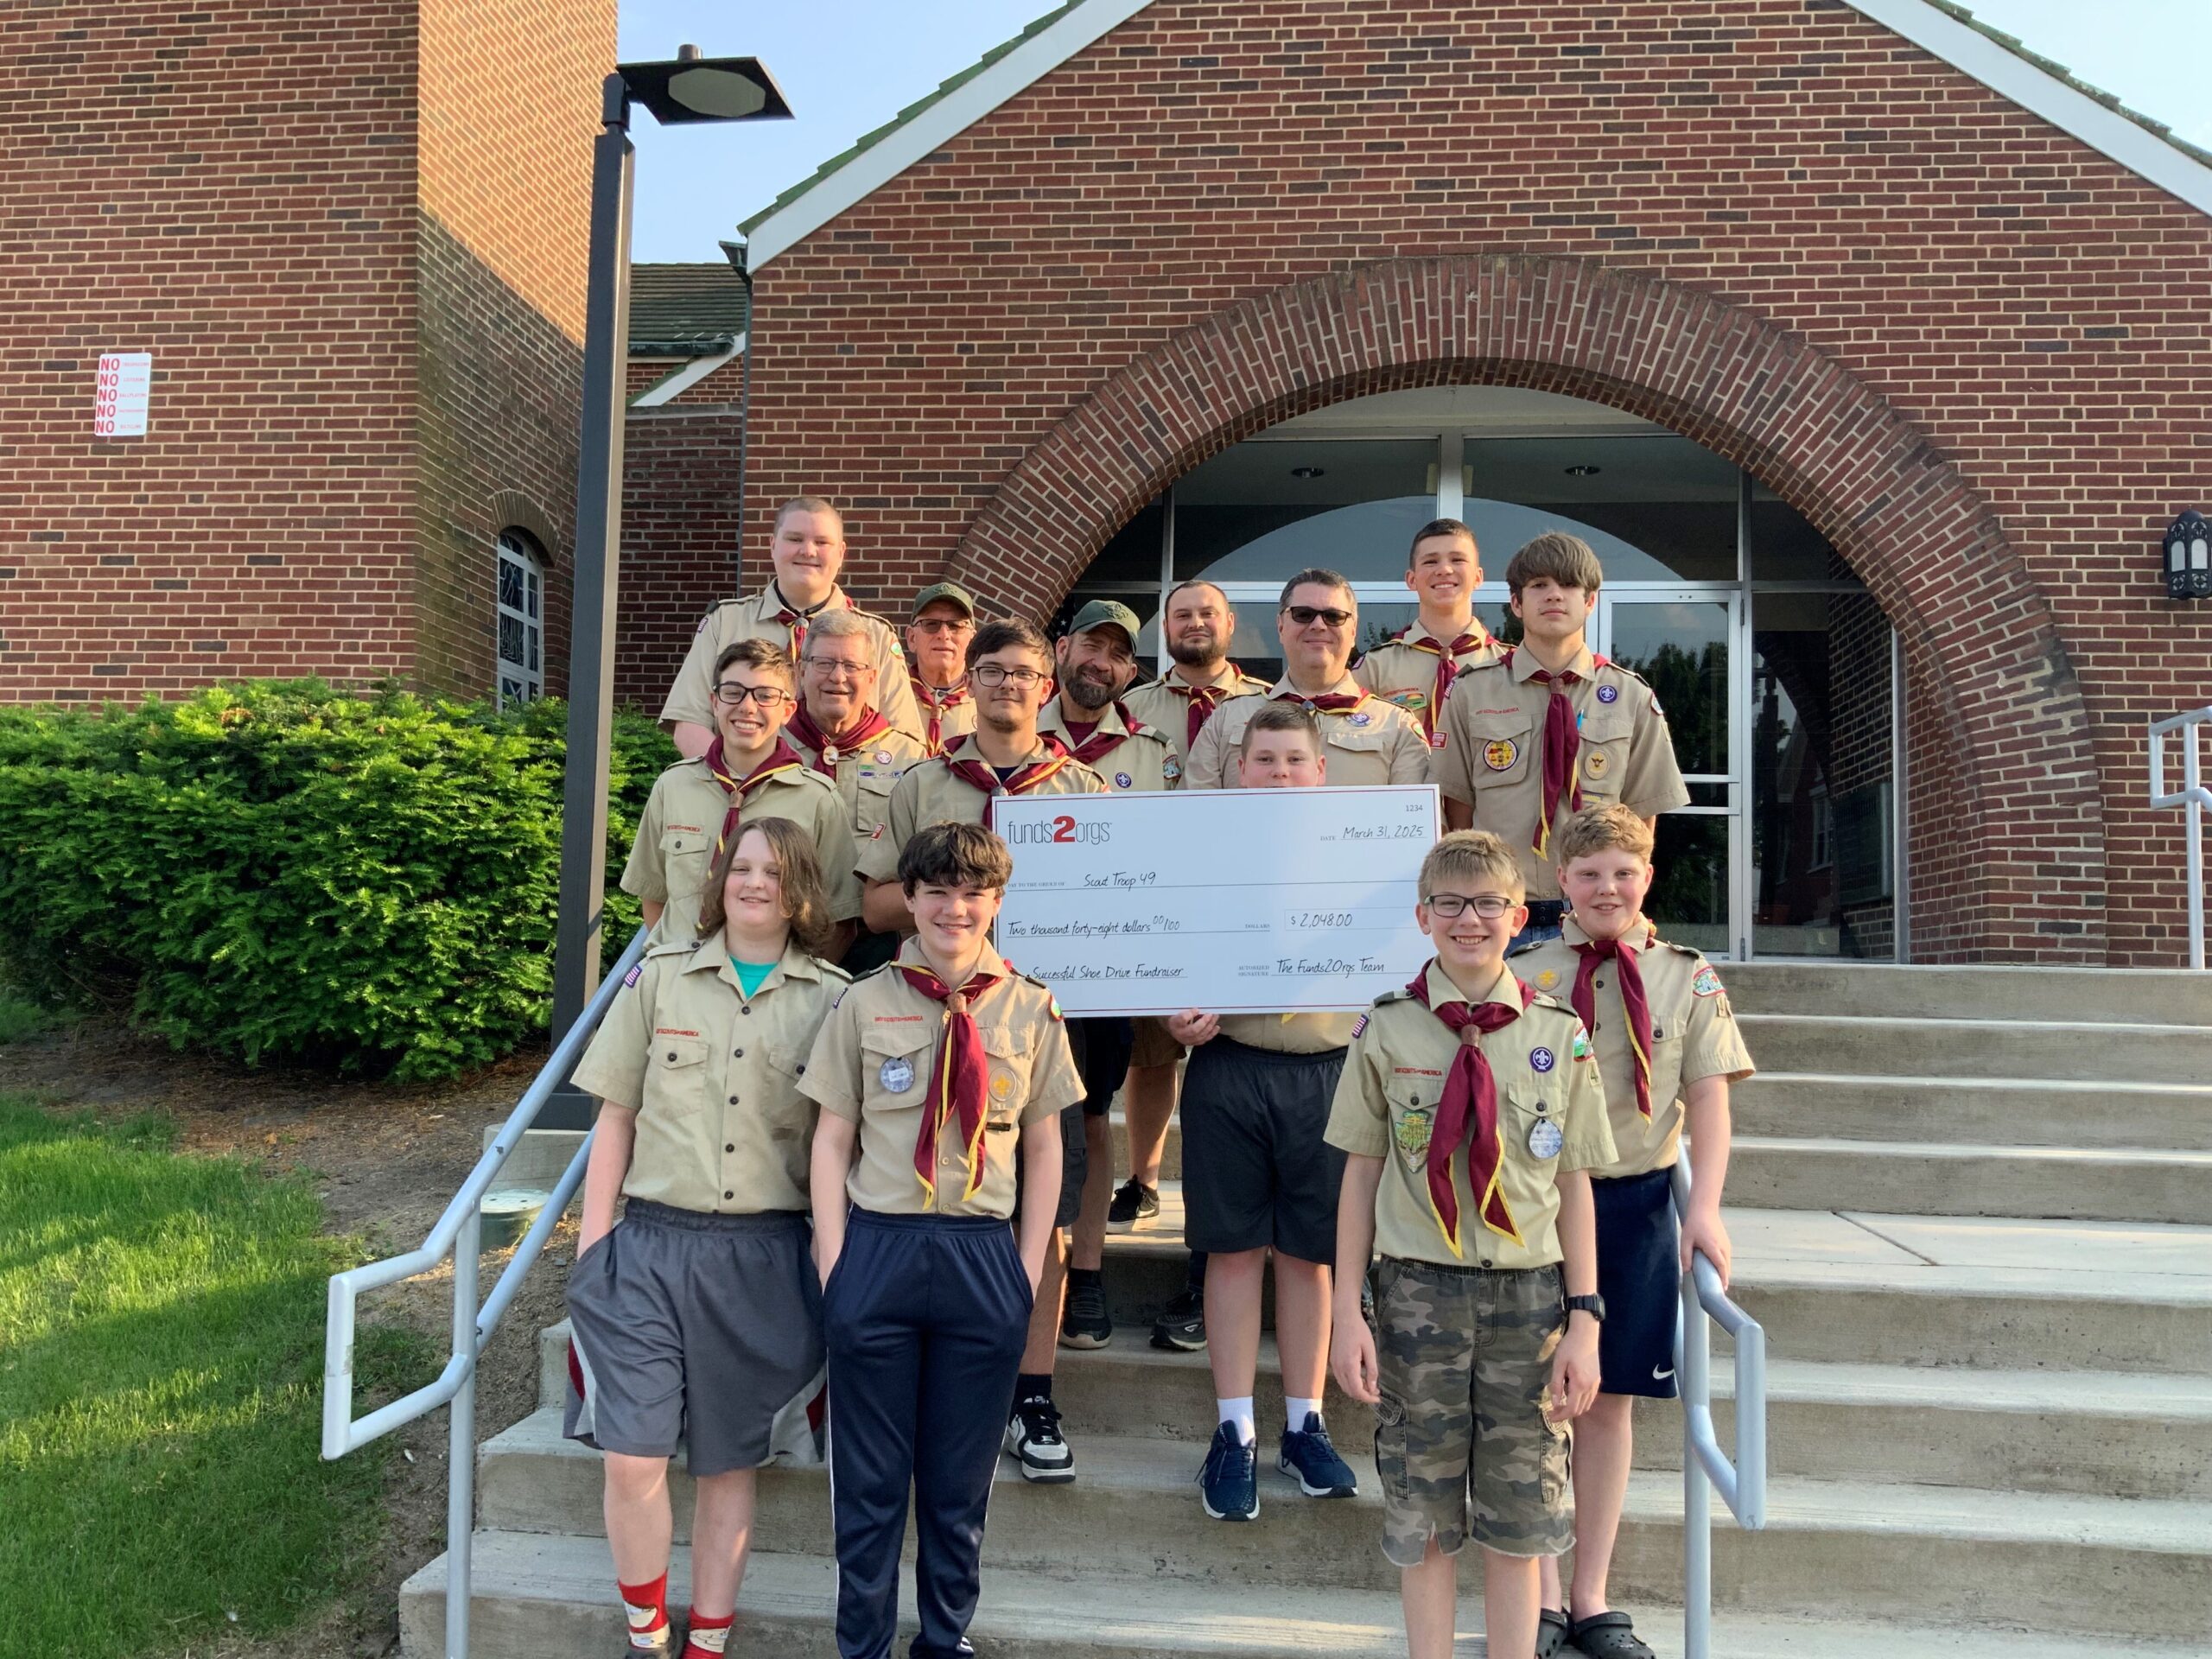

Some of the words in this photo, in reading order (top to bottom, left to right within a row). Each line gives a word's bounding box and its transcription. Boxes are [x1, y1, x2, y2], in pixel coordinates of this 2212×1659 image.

[100, 358, 120, 371] NO
[99, 373, 118, 386] NO
[99, 389, 118, 402] NO
[97, 404, 116, 417] NO
[95, 420, 115, 434] NO
[1343, 827, 1373, 839] March
[1376, 825, 1390, 839] 31,
[1394, 824, 1424, 838] 2025
[1084, 874, 1109, 887] Scout
[1112, 871, 1137, 892] Troop
[1140, 871, 1156, 886] 49
[1290, 915, 1296, 925] $
[1007, 920, 1027, 936] Two
[1031, 923, 1069, 936] thousand
[1071, 920, 1119, 939] forty-eight
[1122, 919, 1151, 933] dollars
[1033, 965, 1076, 981] Successful
[1080, 964, 1101, 978] Shoe
[1106, 966, 1131, 978] Drive
[1135, 963, 1184, 977] Fundraiser
[1276, 958, 1294, 974] The
[1298, 958, 1355, 979] Funds2Orgs
[1359, 957, 1384, 972] Team
